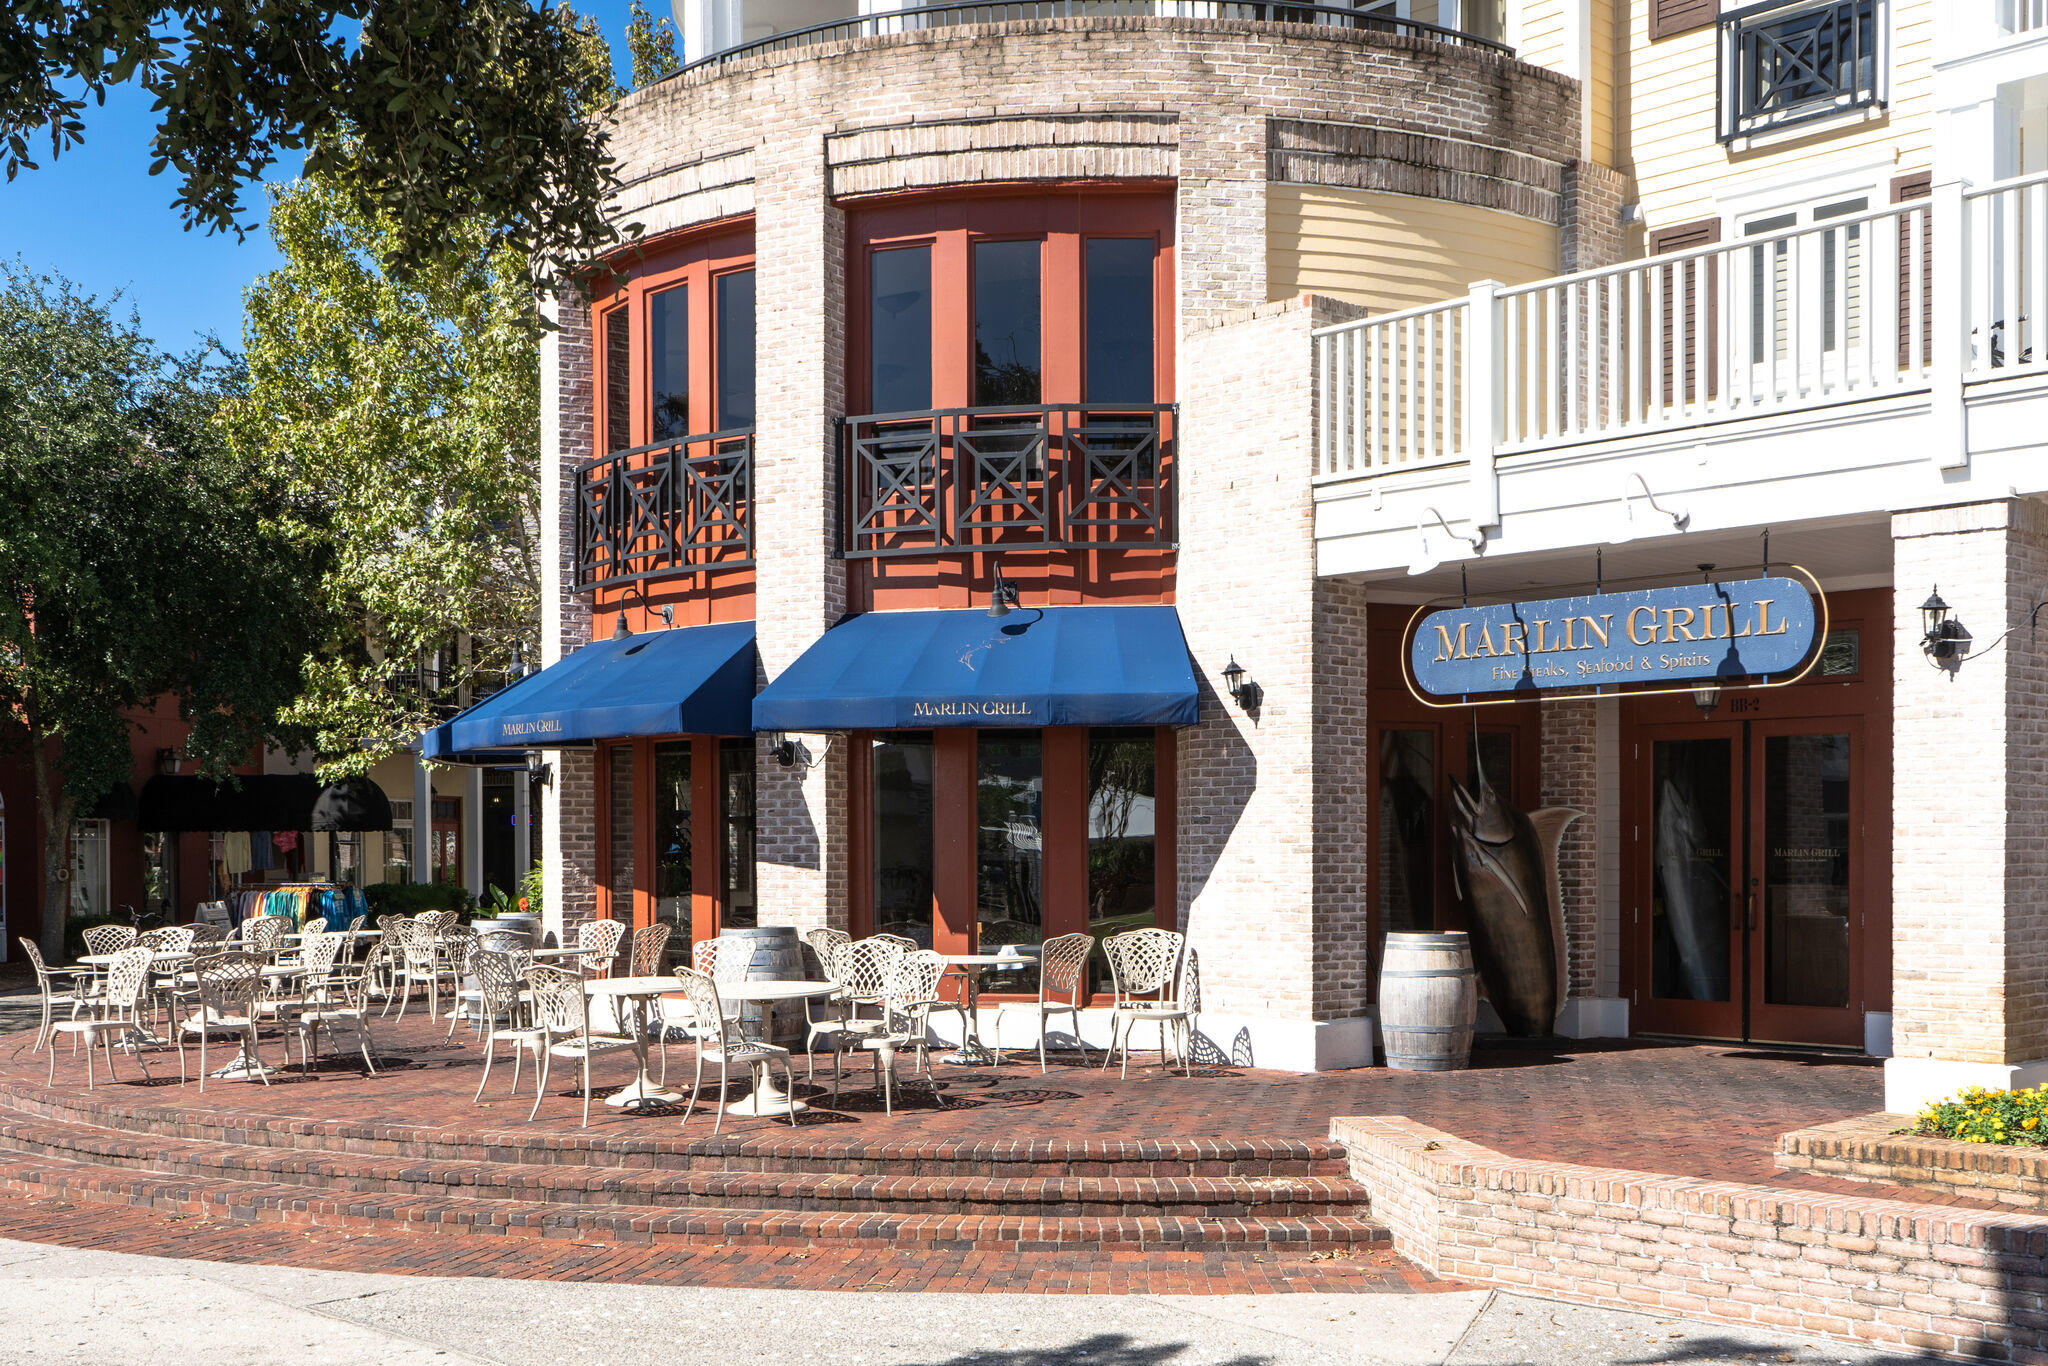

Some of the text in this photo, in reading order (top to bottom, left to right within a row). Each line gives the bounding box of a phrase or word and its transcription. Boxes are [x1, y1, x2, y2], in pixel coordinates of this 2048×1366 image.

[1433, 599, 1787, 663] MARLIN GRILL
[1641, 656, 1652, 670] &
[913, 701, 1032, 716] MARLIN GRILL
[502, 719, 562, 736] MARLIN GRILL
[1774, 848, 1840, 857] MARLIN GRILL
